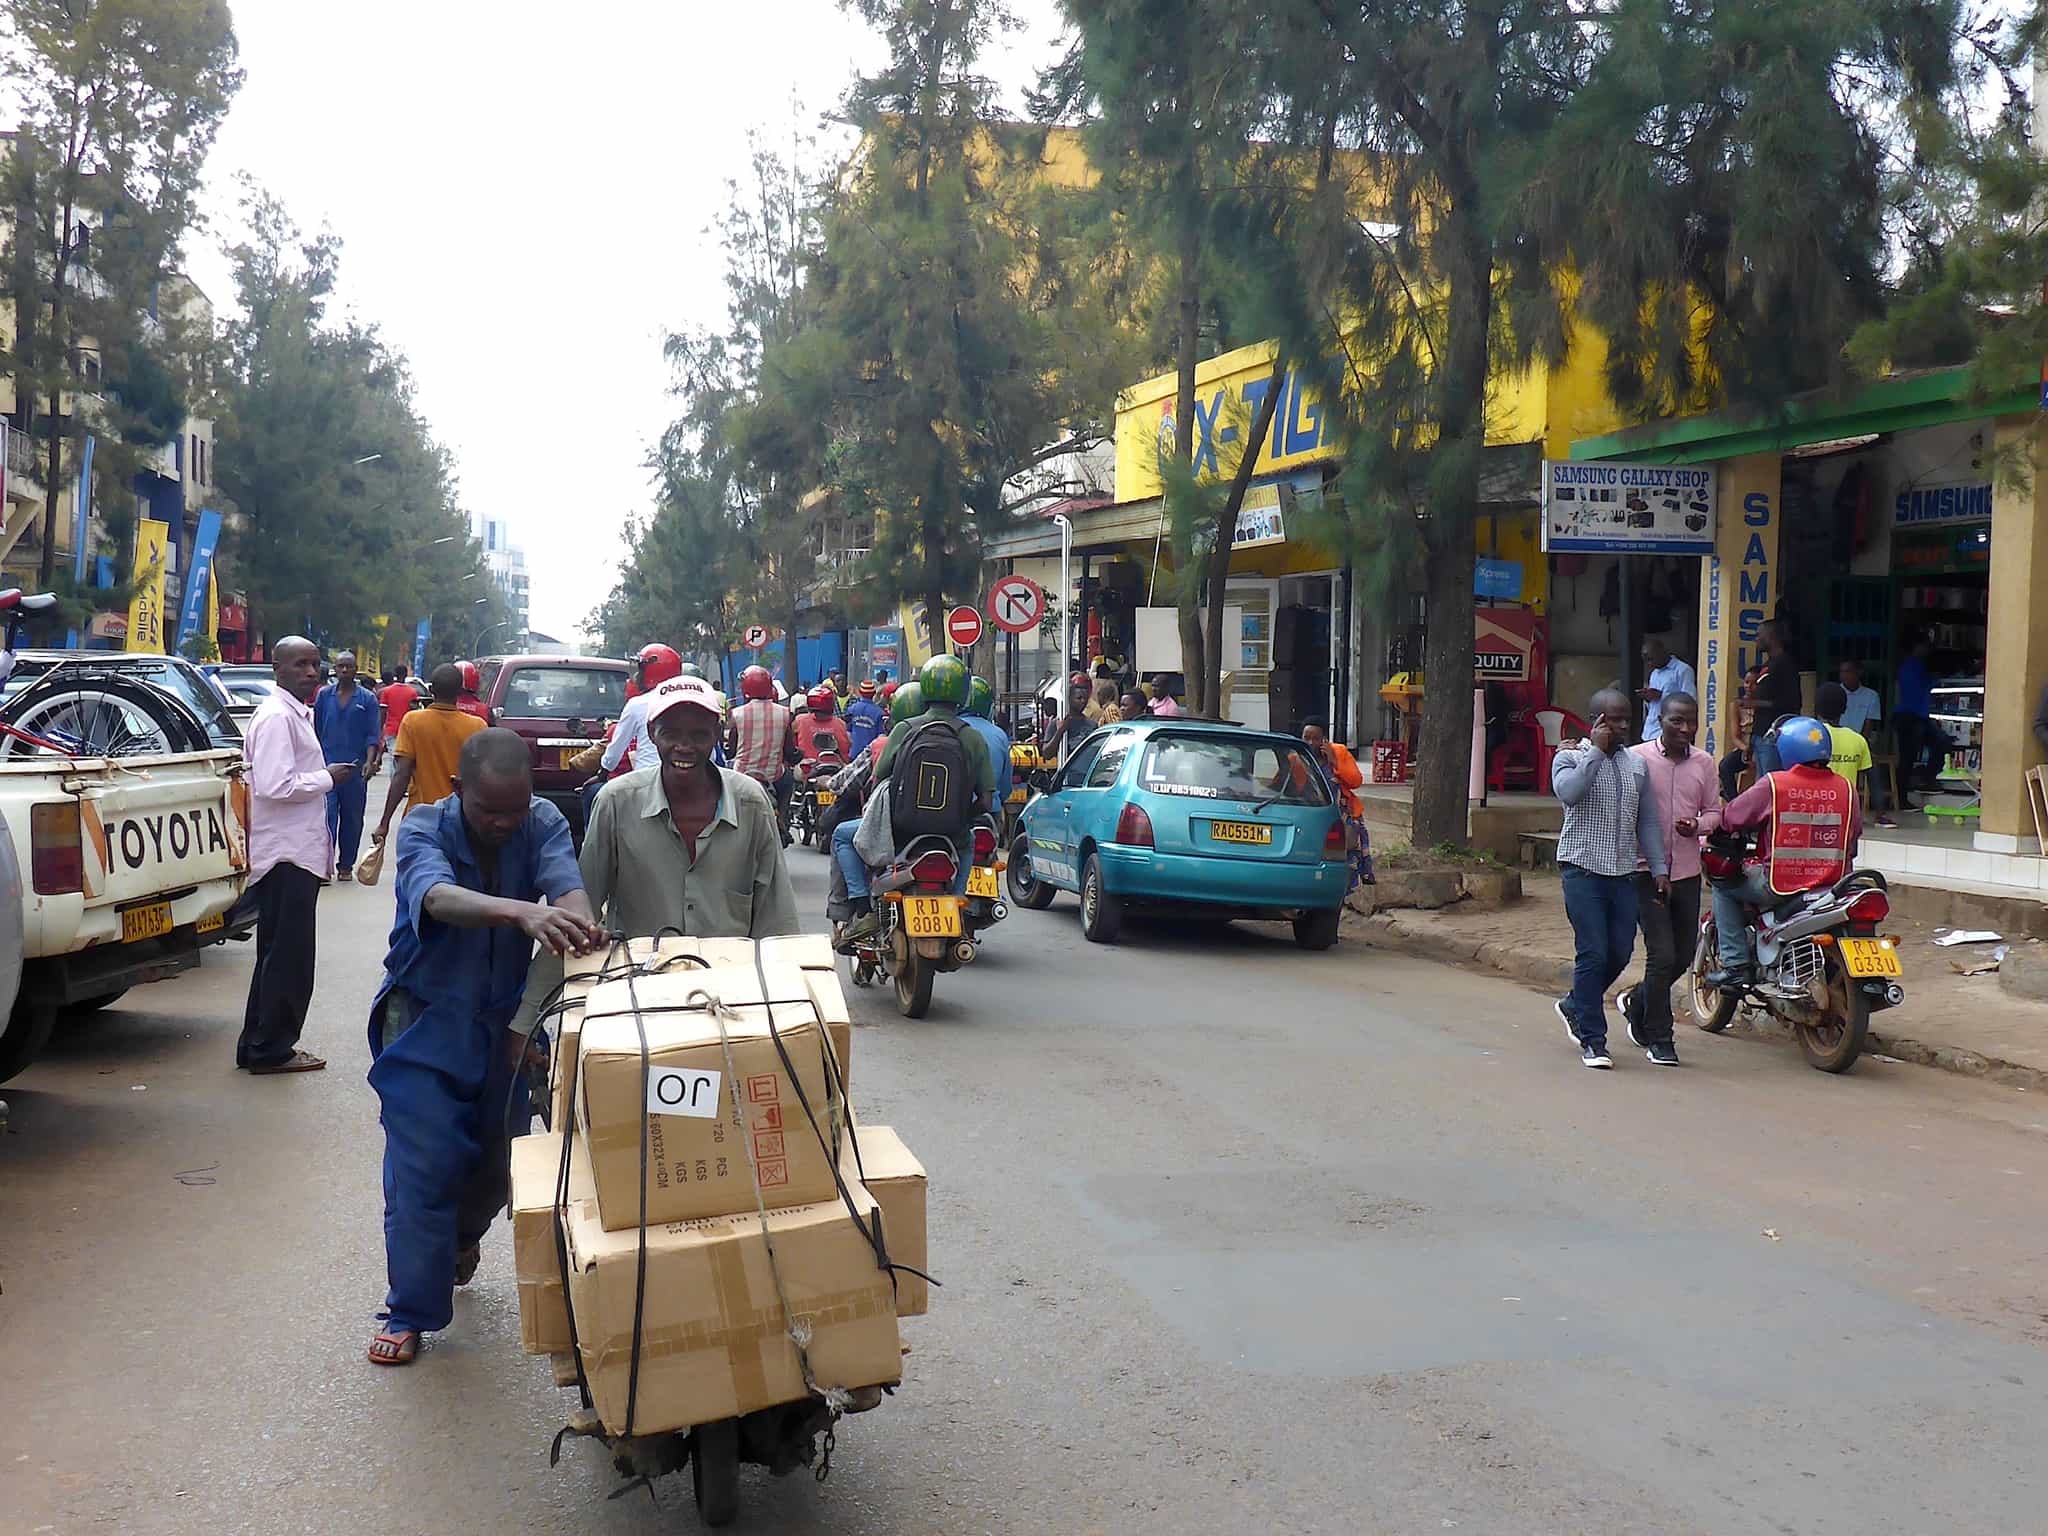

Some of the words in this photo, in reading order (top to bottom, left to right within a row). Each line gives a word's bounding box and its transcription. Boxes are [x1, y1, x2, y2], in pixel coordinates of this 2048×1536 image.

[1193, 368, 1332, 476] X-TIG
[1554, 466, 1616, 485] SAMSUNG
[1621, 468, 1673, 487] GALAXY
[1676, 470, 1709, 489] SHOP
[1709, 556, 1720, 630] PHONE
[1738, 493, 1769, 698] SAMSU
[751, 629, 762, 643] P
[1788, 788, 1837, 800] GASABO
[104, 807, 227, 875] TOYOTA
[675, 1161, 688, 1184] KGS
[695, 1159, 707, 1182] KGS
[716, 1157, 728, 1177] PCS
